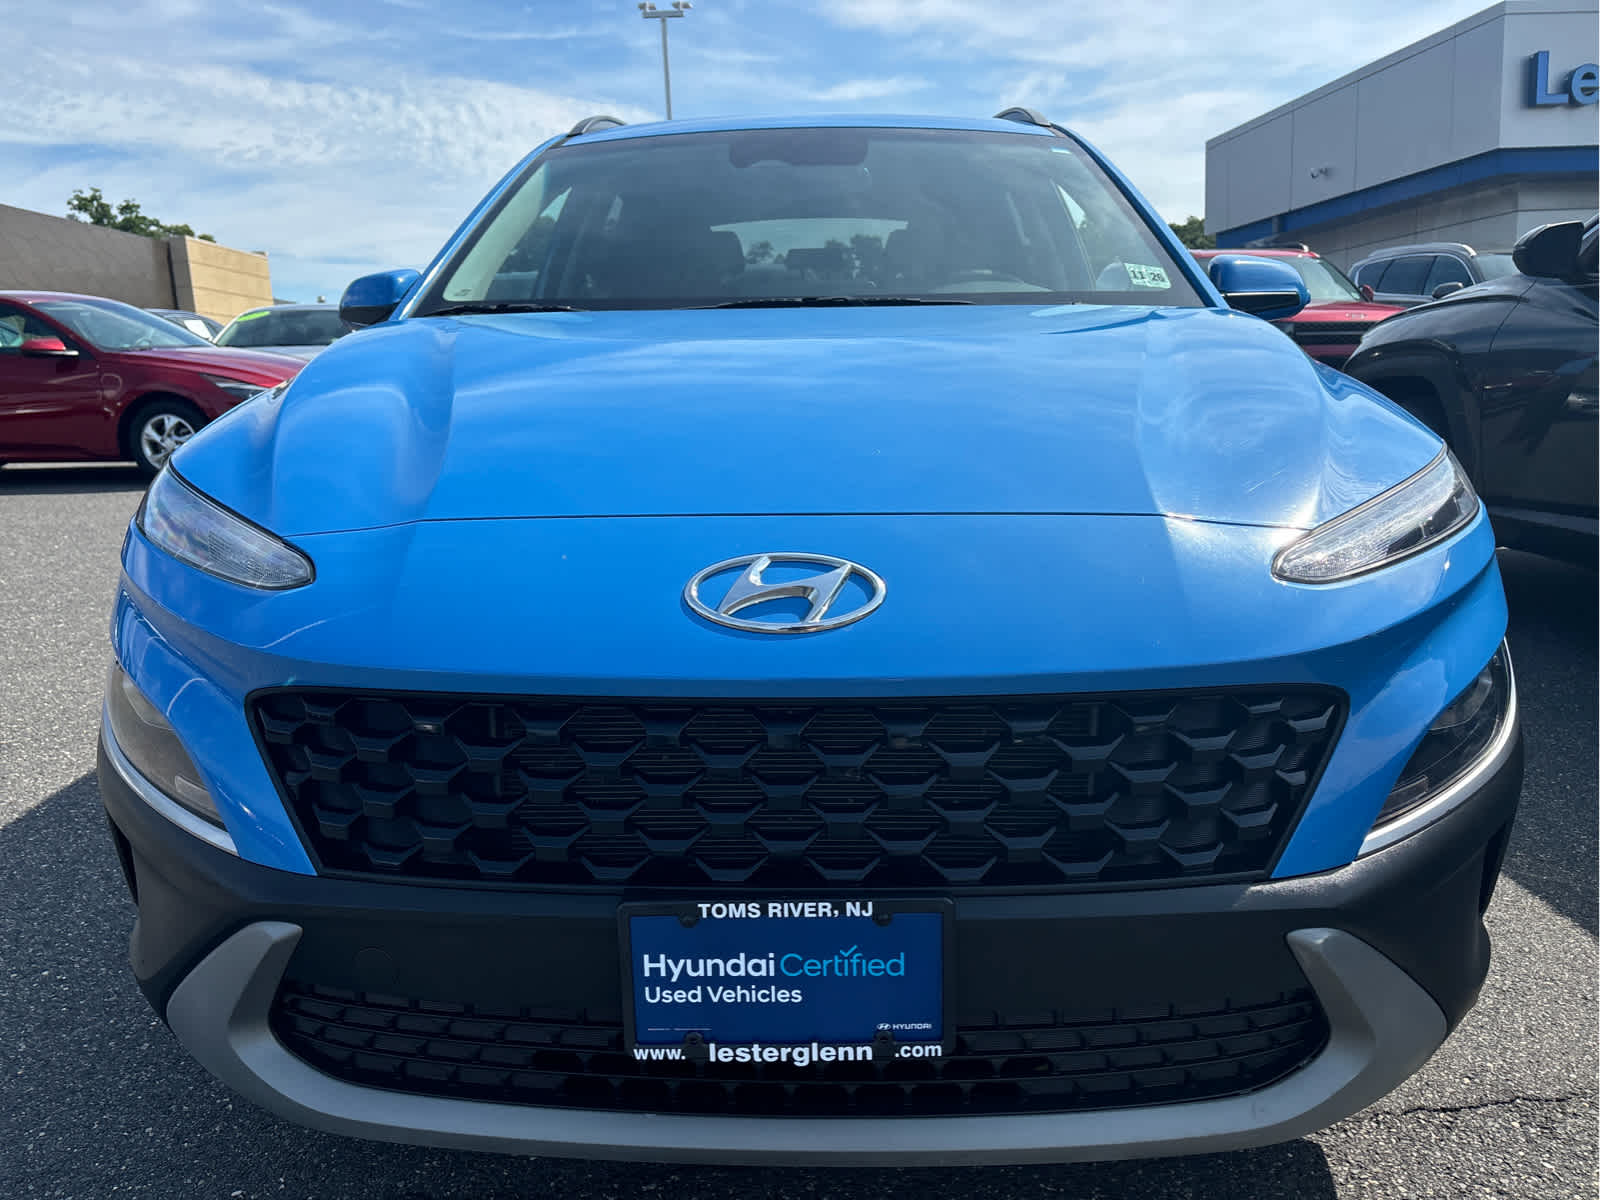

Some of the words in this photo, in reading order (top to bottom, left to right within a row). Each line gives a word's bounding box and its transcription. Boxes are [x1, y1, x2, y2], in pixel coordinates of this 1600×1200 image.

[1130, 269, 1146, 280] 11
[697, 902, 761, 919] TOMS
[768, 901, 839, 918] RIVER,
[845, 901, 874, 917] NJ
[642, 952, 775, 982] Hyundai
[780, 945, 905, 977] Certified
[644, 985, 702, 1003] Used
[706, 985, 803, 1003] Vehicles
[633, 1047, 686, 1061] www.
[708, 1042, 873, 1067] lesterglenn
[894, 1044, 943, 1058] .com
